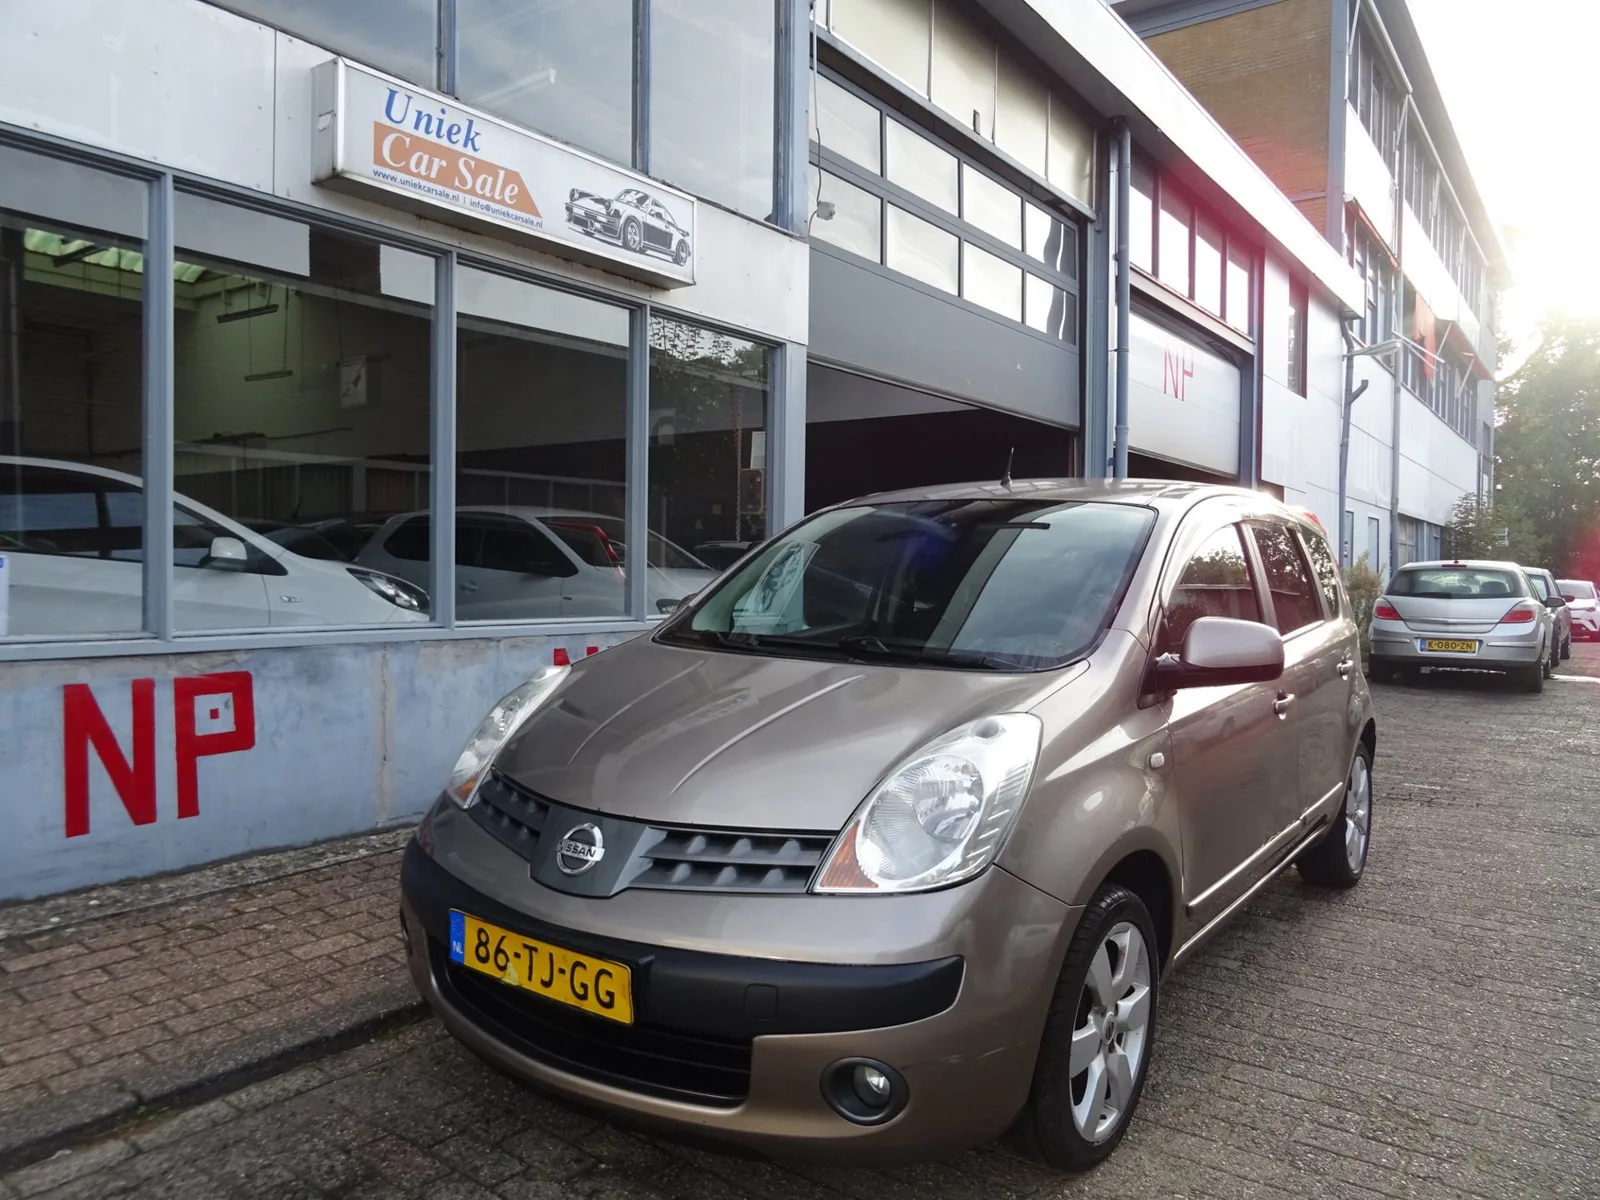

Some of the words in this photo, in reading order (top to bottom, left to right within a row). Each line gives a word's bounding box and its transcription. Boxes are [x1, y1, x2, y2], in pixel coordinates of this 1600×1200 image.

[384, 87, 482, 152] Uniek
[372, 168, 460, 202] www.uniekcarsale.nl
[469, 199, 543, 229] info@uniekcarsale.nl
[382, 132, 447, 178] Car
[454, 156, 519, 204] Sale
[1427, 641, 1473, 650] K-080-ZN
[63, 670, 256, 838] NP
[560, 841, 597, 858] NISSAN
[452, 941, 464, 954] NL
[474, 927, 616, 1010] 86-TJ-GG
